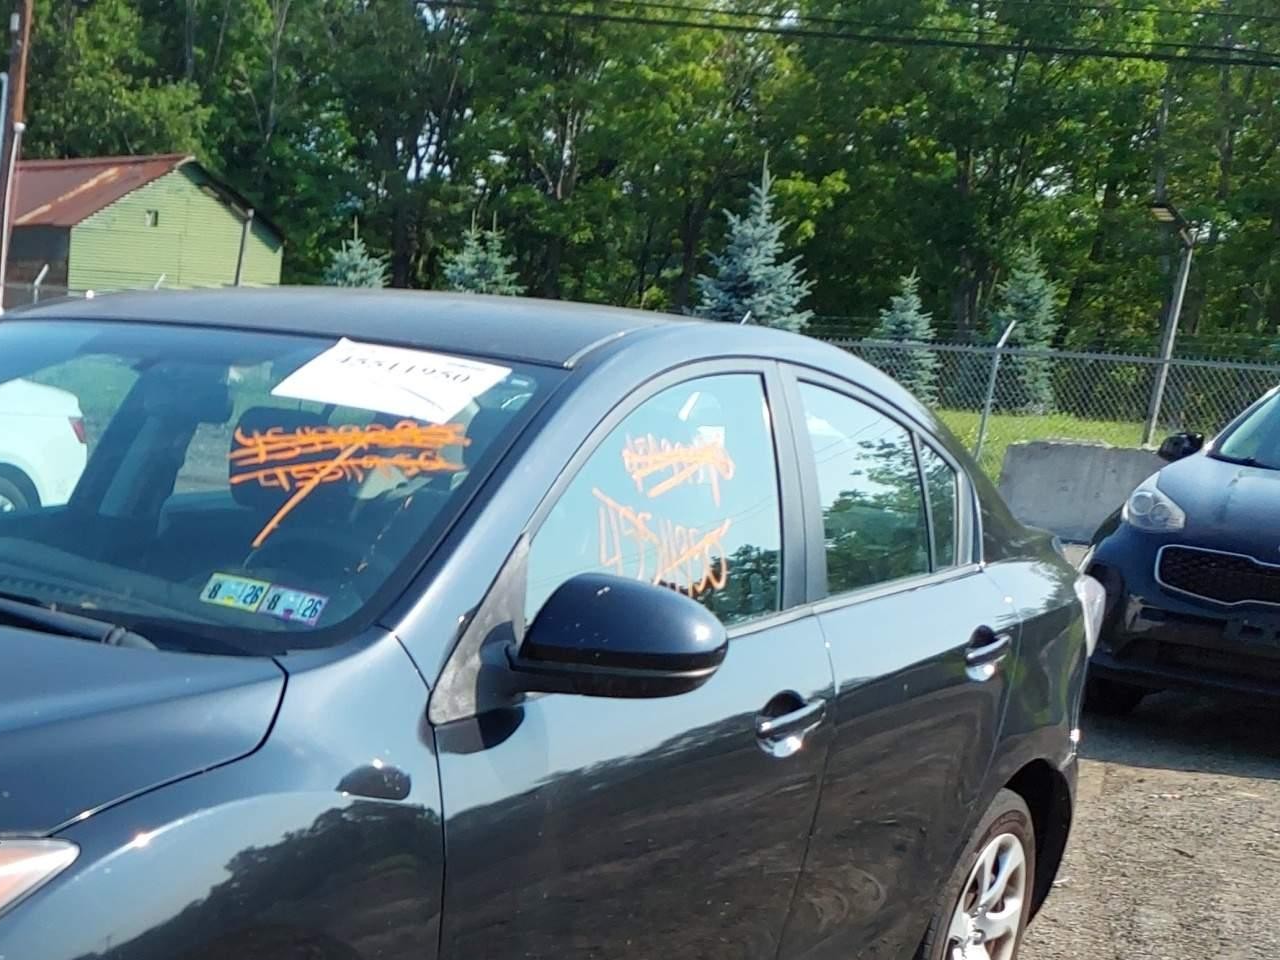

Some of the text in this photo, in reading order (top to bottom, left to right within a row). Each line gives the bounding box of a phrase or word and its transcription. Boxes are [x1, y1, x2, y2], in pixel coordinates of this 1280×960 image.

[208, 583, 263, 605] 8 26
[267, 593, 322, 618] 8 26
